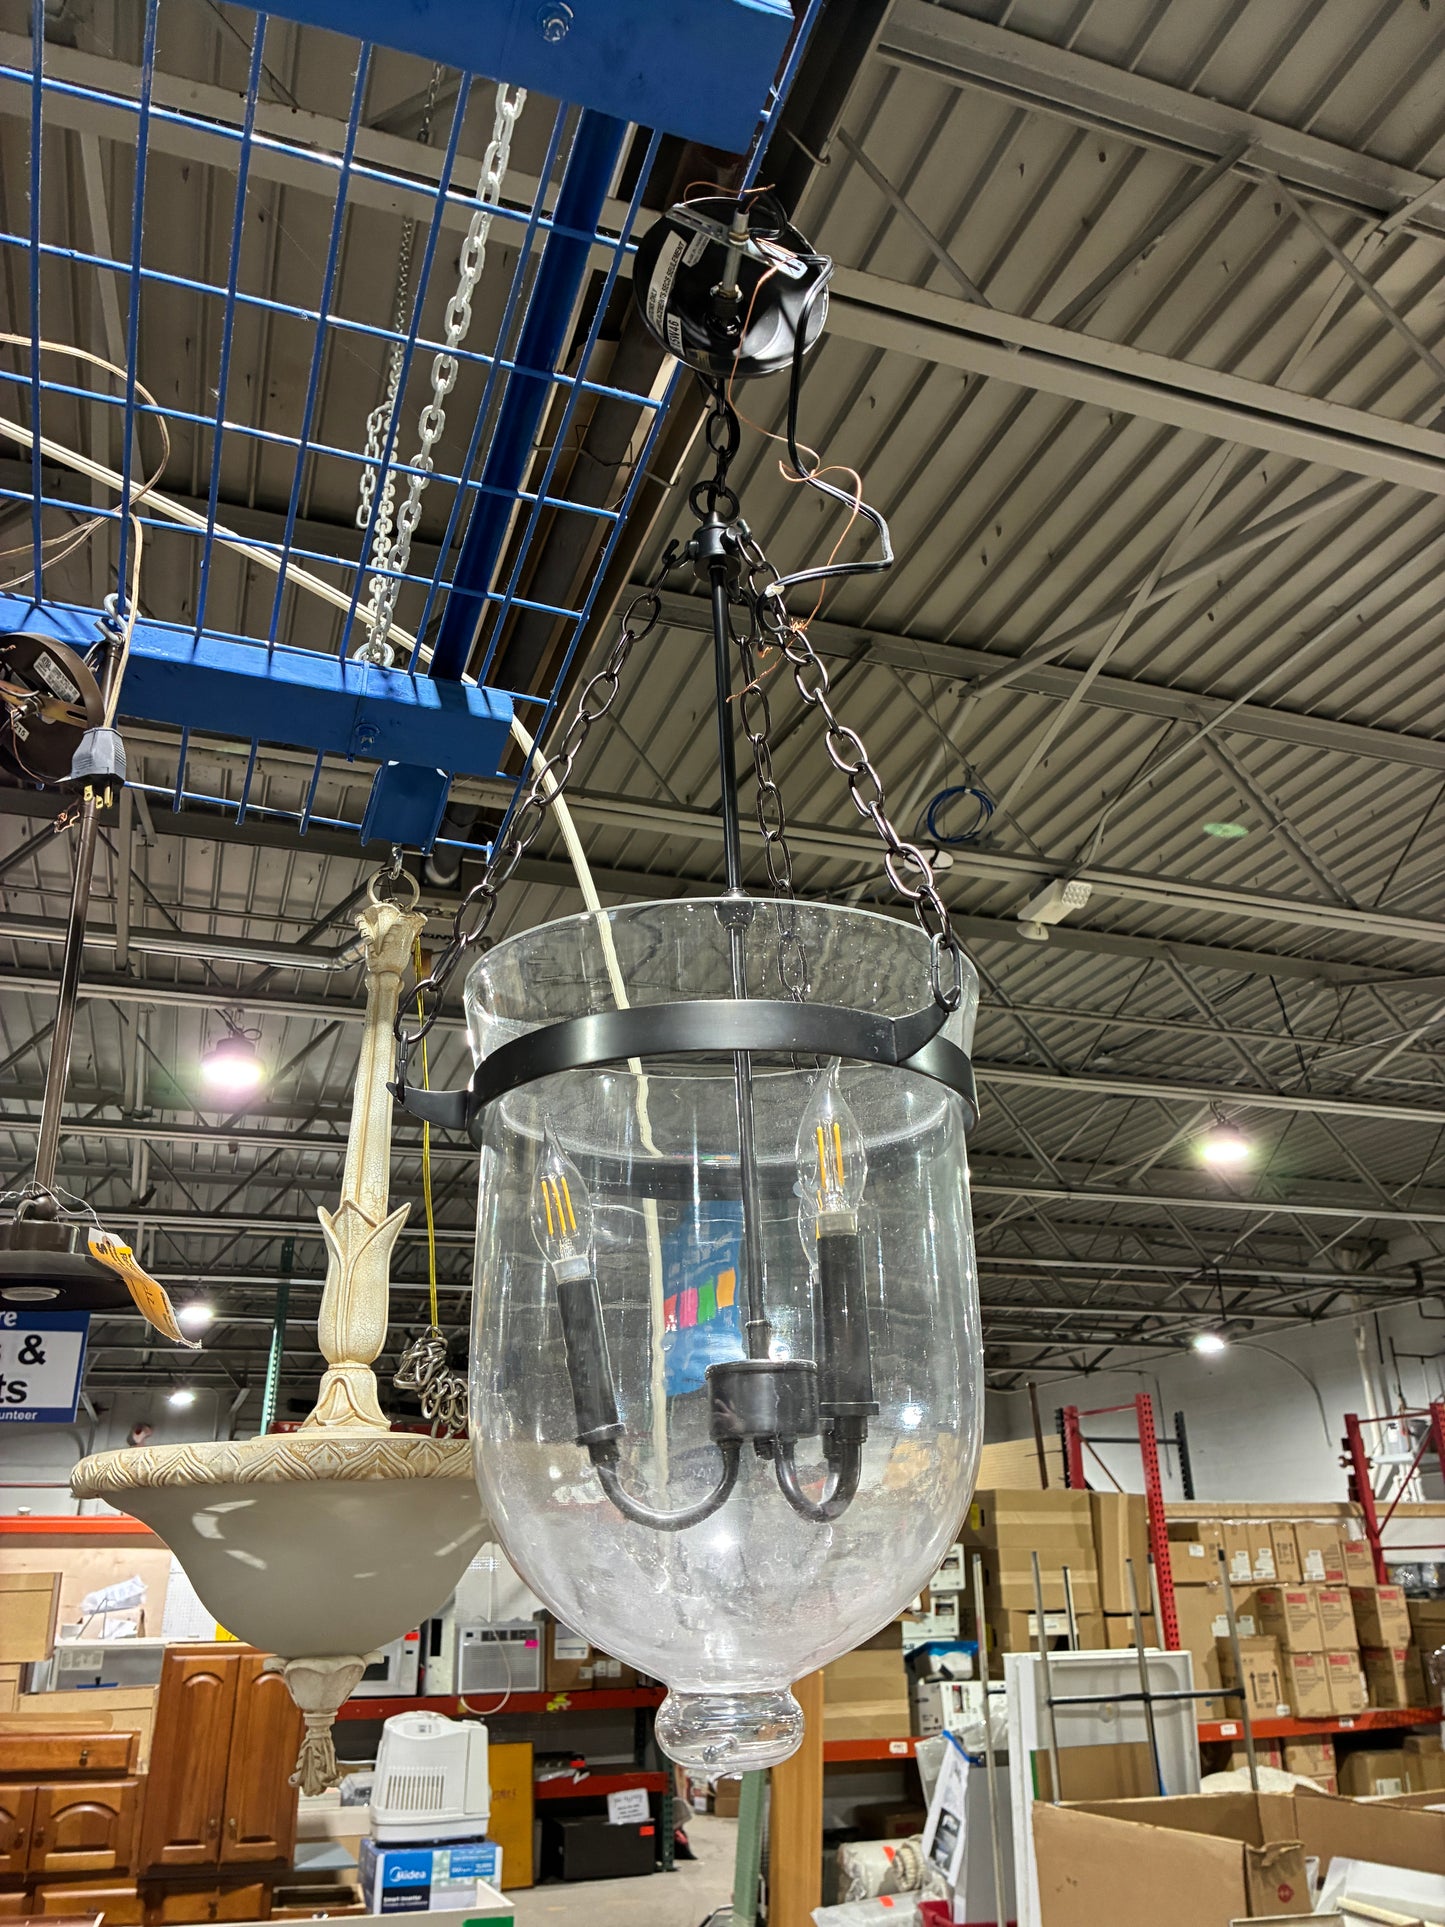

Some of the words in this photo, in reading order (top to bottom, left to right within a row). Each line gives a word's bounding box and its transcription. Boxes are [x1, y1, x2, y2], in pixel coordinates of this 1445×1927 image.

[666, 240, 684, 278] SEULEMENT
[18, 1334, 46, 1365] &
[392, 1867, 427, 1881] Midea
